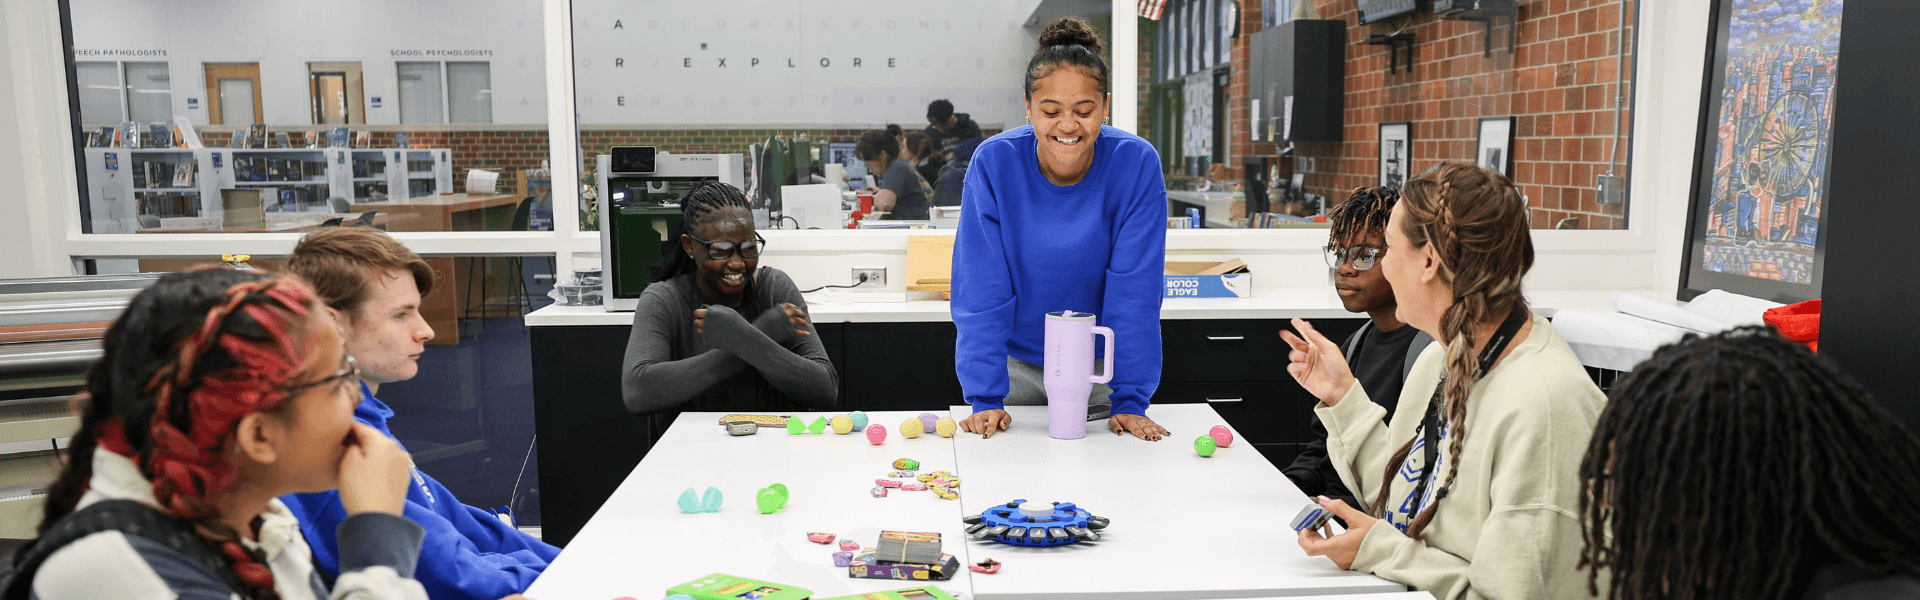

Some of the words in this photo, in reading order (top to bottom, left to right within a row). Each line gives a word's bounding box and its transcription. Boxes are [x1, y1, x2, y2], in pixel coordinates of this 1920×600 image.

[103, 49, 168, 57] PATHOLOGISTS
[390, 49, 424, 57] SCHOOL
[426, 49, 493, 57] PSYCHOLOGISTS
[683, 57, 895, 68] EXPLORE
[1166, 280, 1199, 288] COLOR
[1167, 288, 1198, 296] EAGLE
